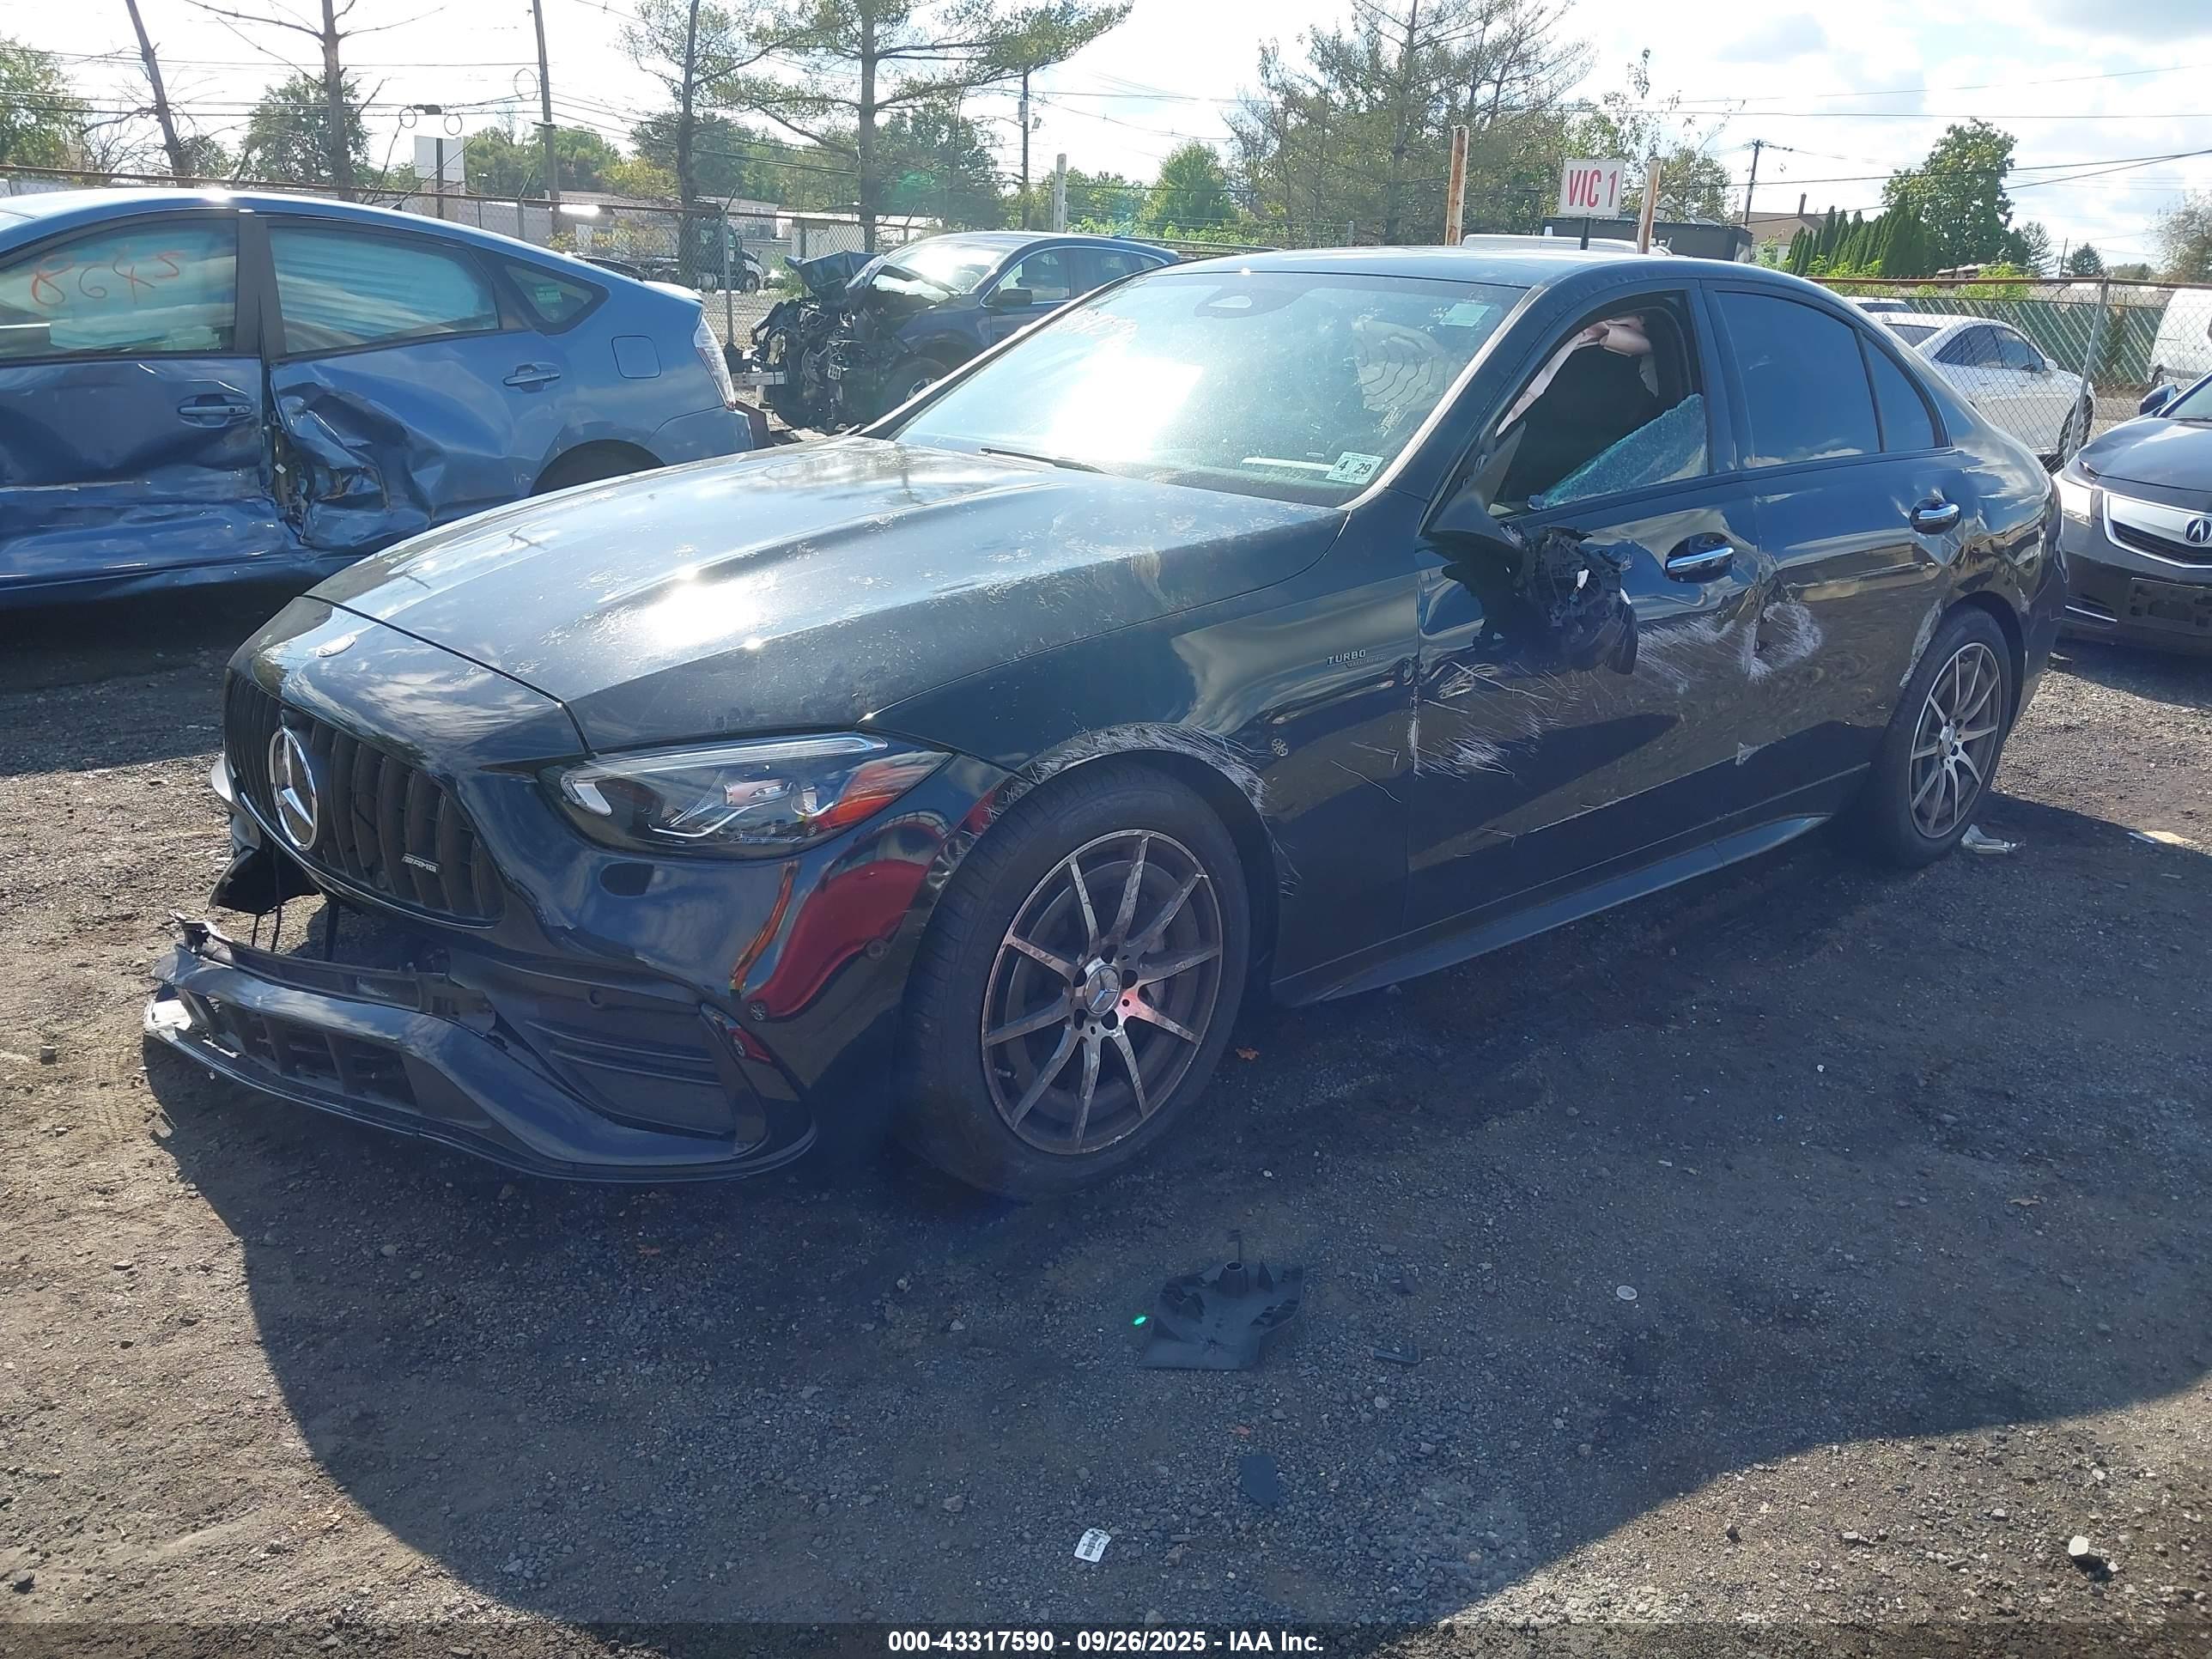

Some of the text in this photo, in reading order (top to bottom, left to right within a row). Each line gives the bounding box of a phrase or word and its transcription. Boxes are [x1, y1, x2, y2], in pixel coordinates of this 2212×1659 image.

[1569, 169, 1618, 208] VIC 1
[1339, 460, 1372, 475] 4 29
[1327, 649, 1366, 665] TURBO
